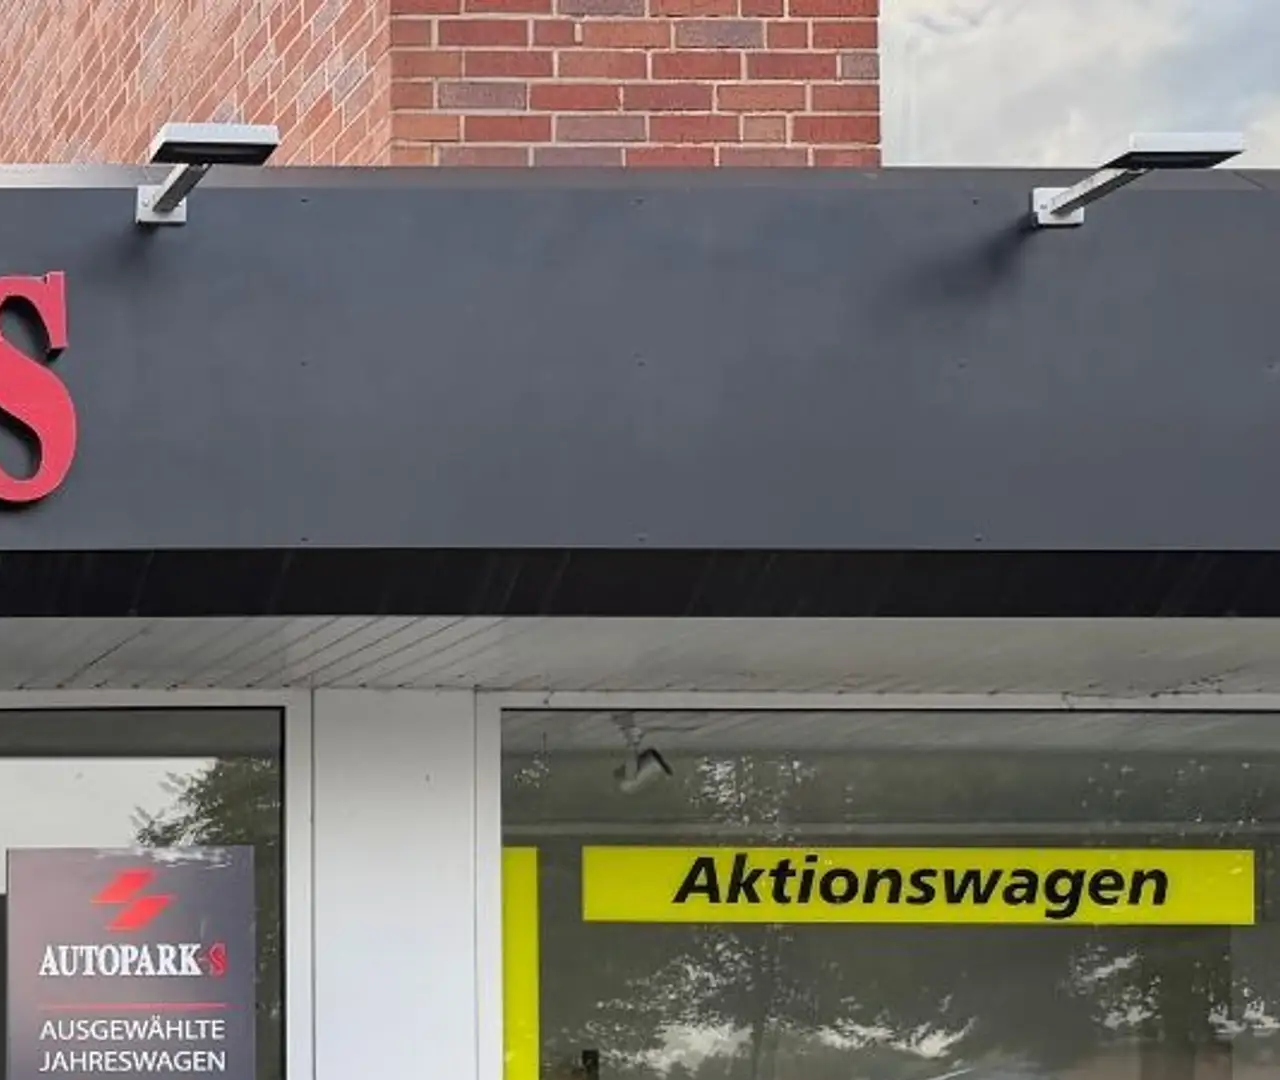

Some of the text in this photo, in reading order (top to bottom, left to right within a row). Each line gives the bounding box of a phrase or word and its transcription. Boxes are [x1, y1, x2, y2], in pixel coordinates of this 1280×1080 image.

[673, 854, 1169, 919] Aktionswagen
[39, 943, 227, 977] AUTOPARK-S
[39, 1015, 226, 1040] AUSGEWÄHLTE
[39, 1051, 226, 1072] JAHRESWAGEN
